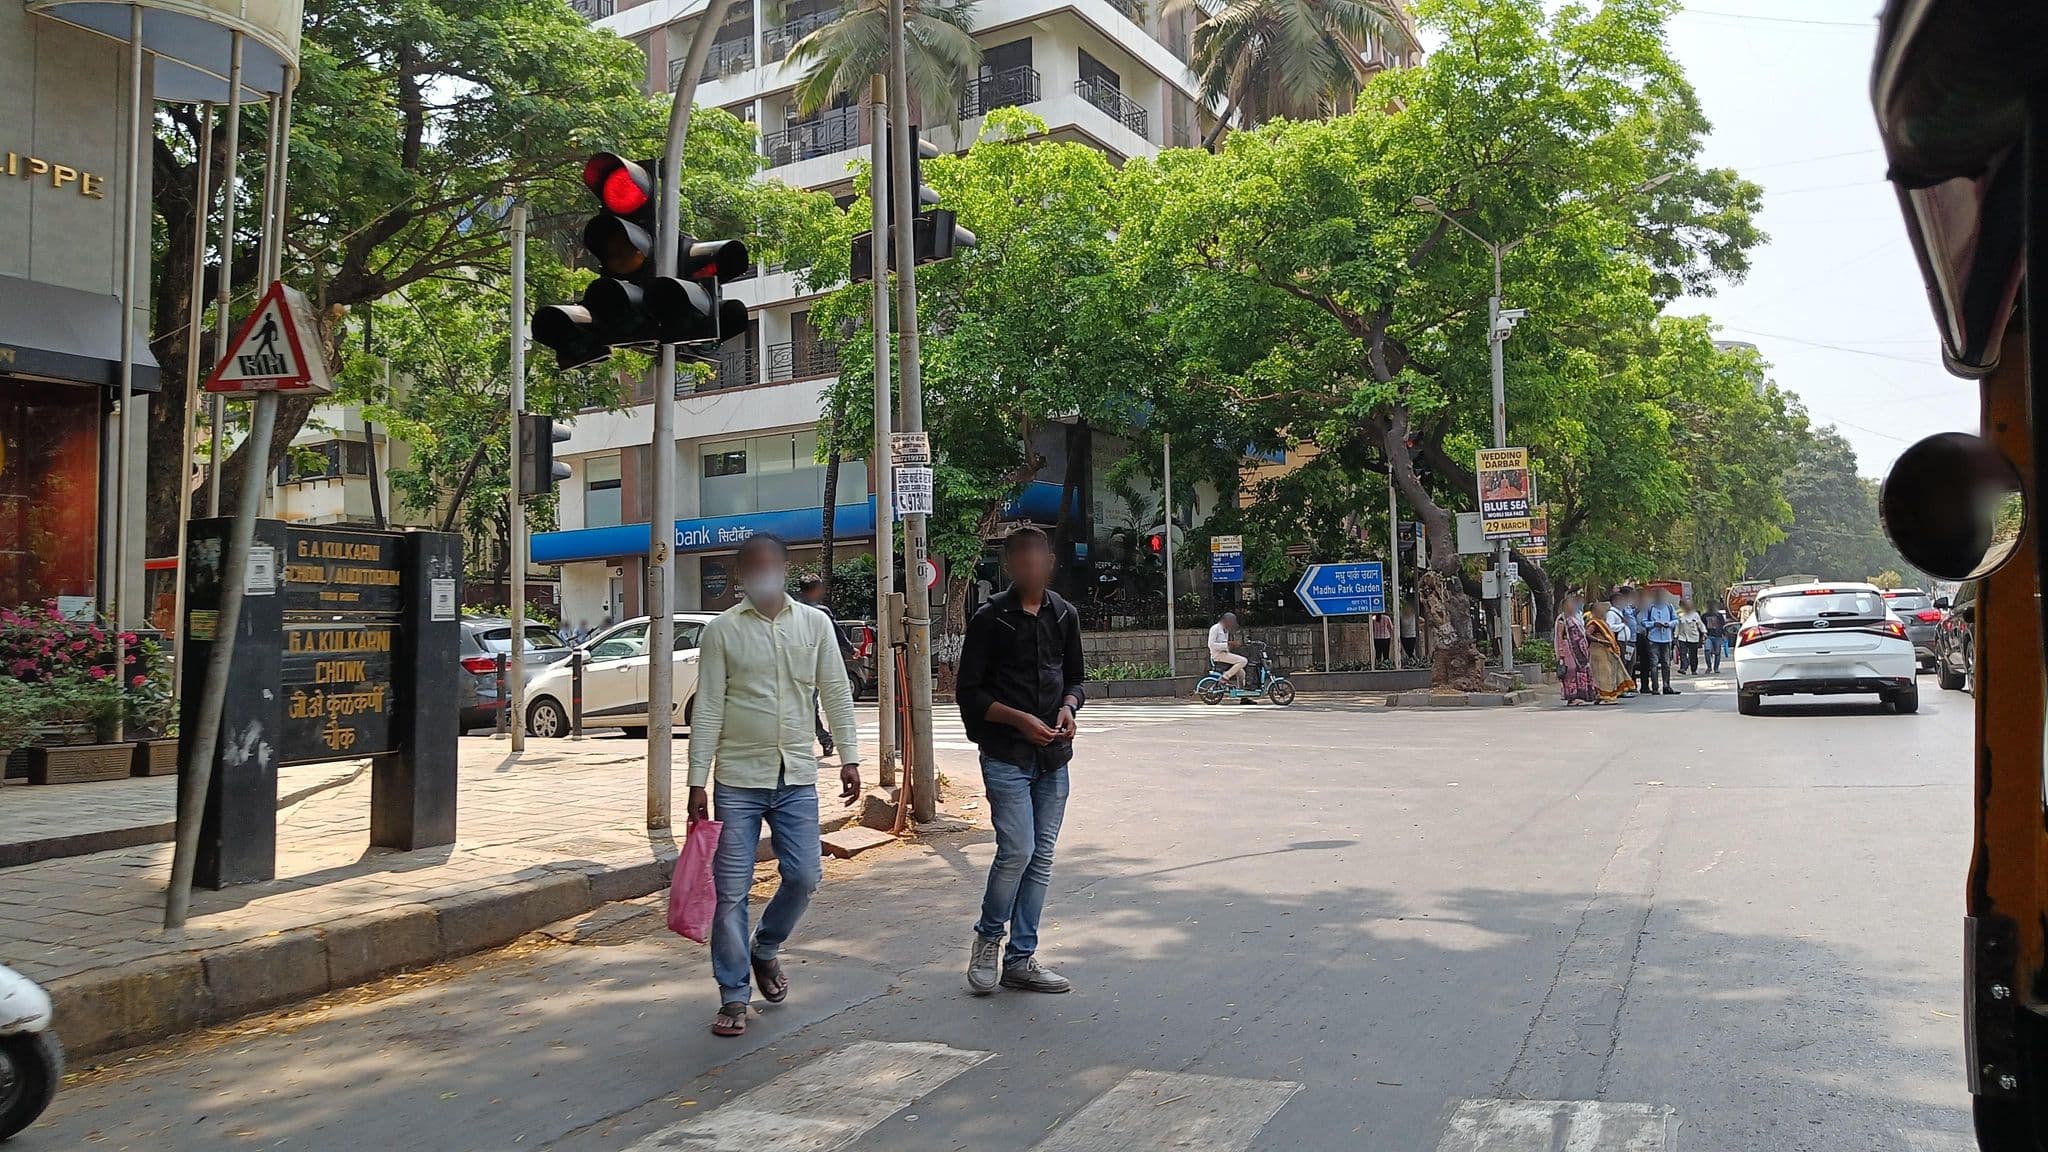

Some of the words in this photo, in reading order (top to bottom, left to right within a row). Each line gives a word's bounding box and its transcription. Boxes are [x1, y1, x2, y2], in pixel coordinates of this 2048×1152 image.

[0, 152, 104, 199] IPPE
[1481, 451, 1522, 461] WEDDING
[1485, 459, 1520, 469] DARBAR
[1484, 501, 1509, 512] BLUE
[1510, 500, 1528, 510] SEA
[1485, 521, 1499, 532] 29
[1501, 520, 1528, 530] MARCH
[675, 526, 710, 546] bank
[1346, 567, 1360, 580] पार्क
[1361, 569, 1379, 580] उद्यान
[1312, 585, 1336, 595] Madhu
[1338, 584, 1353, 594] Park
[1355, 583, 1380, 593] Garden
[315, 660, 367, 683] CHOWK
